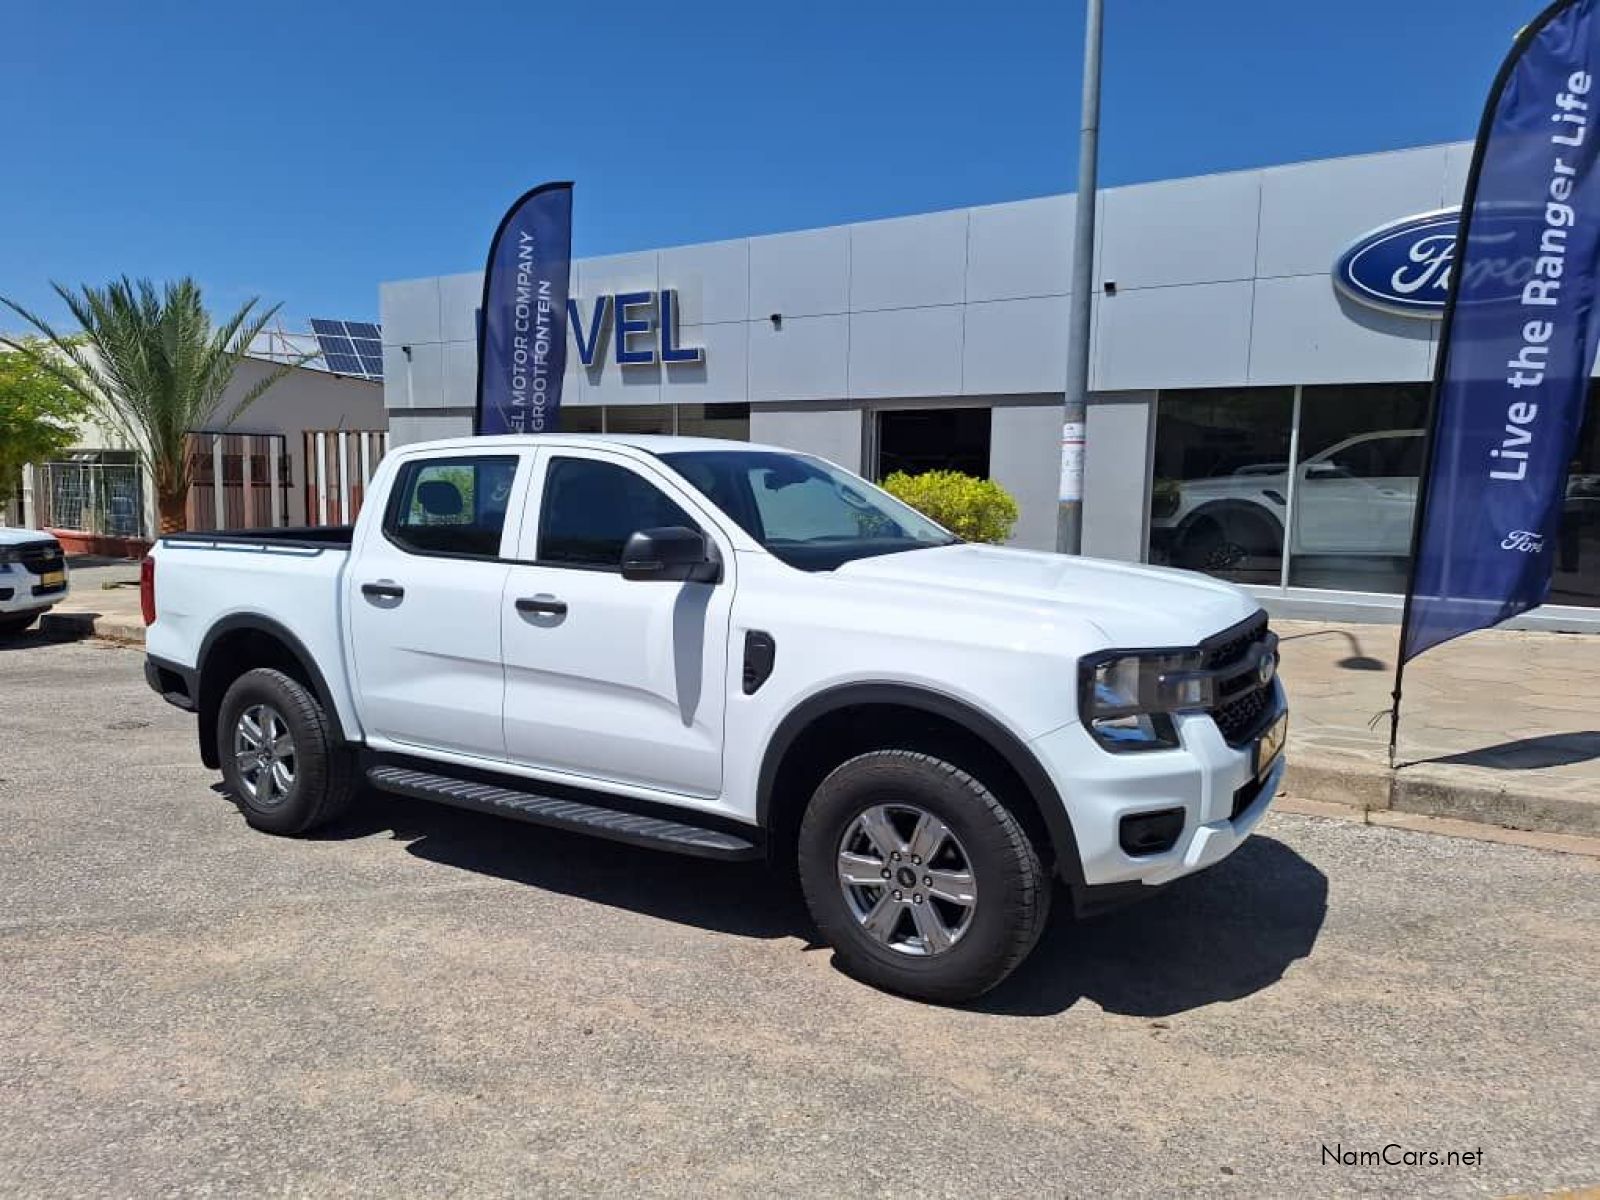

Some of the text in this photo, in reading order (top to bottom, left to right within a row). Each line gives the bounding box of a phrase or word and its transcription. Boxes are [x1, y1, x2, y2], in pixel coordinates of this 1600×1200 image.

[514, 231, 536, 333] COMPANY
[1490, 70, 1593, 481] Live the Ranger Life
[512, 335, 529, 407] MOTOR
[531, 280, 552, 431] GROOTFONTEIN
